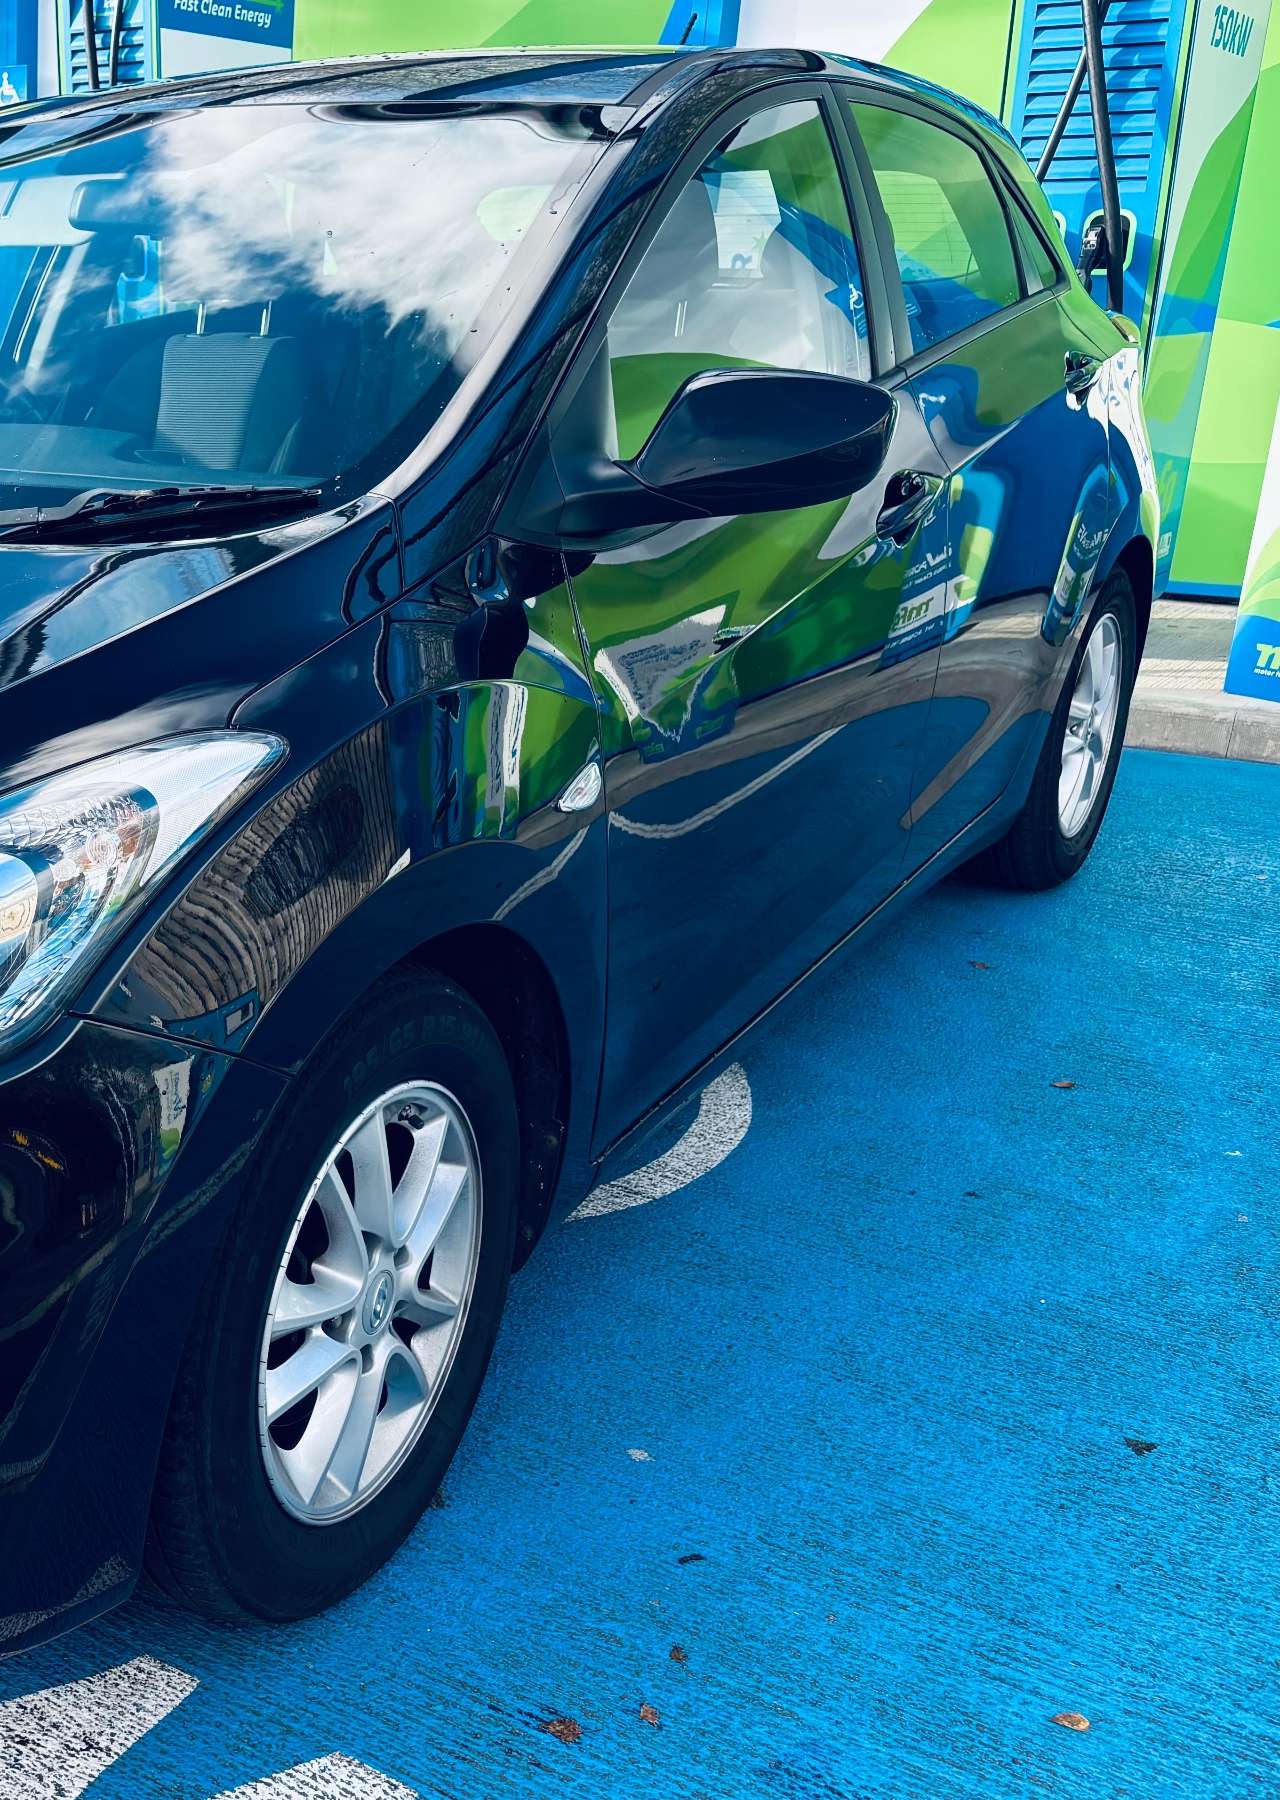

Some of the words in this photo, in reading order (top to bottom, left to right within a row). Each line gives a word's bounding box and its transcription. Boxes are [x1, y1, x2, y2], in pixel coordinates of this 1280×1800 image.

[200, 0, 233, 18] Clean
[234, 4, 272, 28] Energy
[1210, 4, 1254, 57] 150kW
